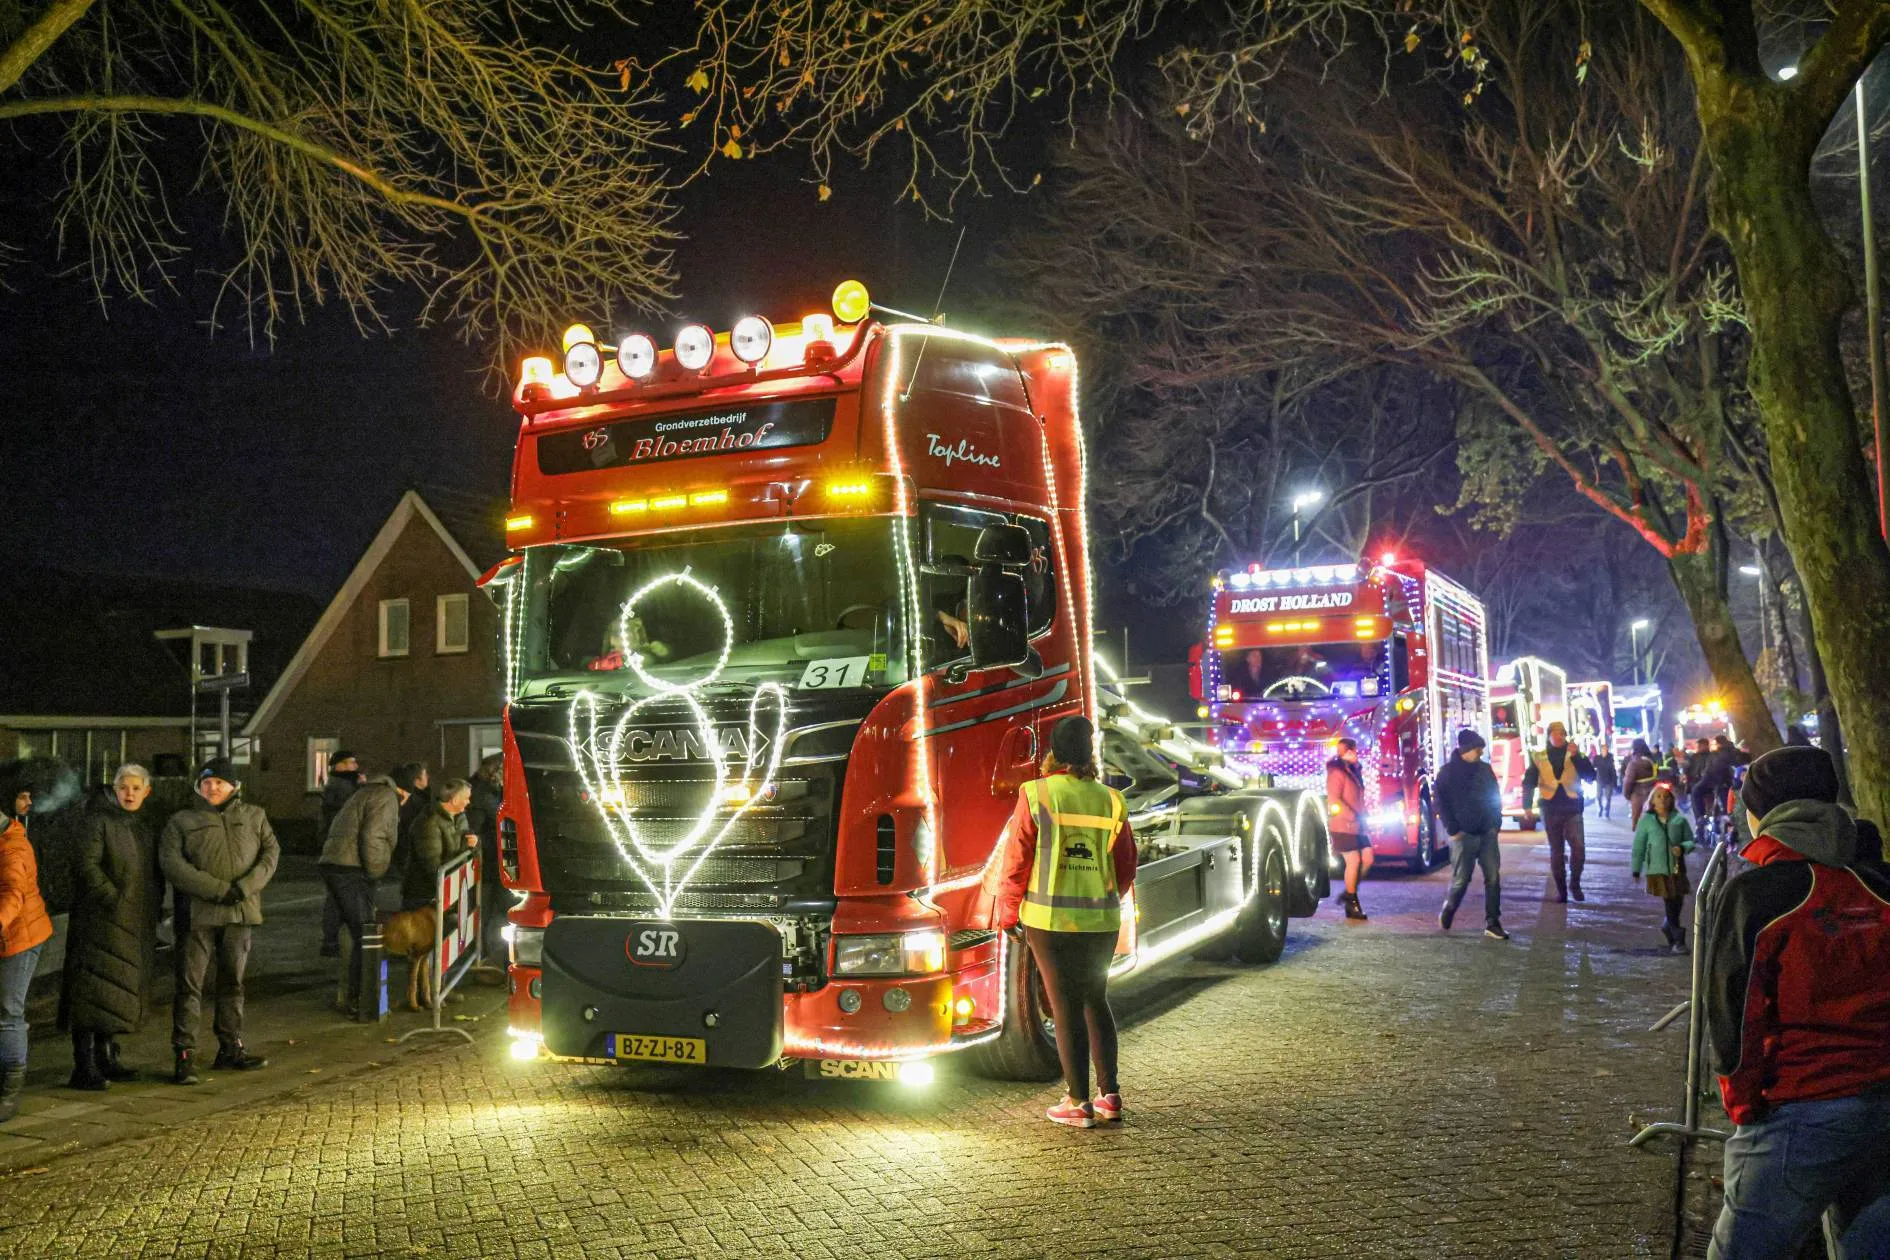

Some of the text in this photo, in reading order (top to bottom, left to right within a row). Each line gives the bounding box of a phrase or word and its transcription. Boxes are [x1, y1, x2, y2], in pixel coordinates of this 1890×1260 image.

[655, 412, 747, 432] Grondverzetbedrijf
[628, 423, 774, 461] Bloemhof
[926, 433, 1000, 467] Topline
[1230, 592, 1352, 613] DROST HOLLAND
[805, 663, 850, 688] 31
[637, 930, 679, 957] SR
[622, 1037, 696, 1060] BZ-ZJ-82
[820, 1059, 900, 1080] SCANI
